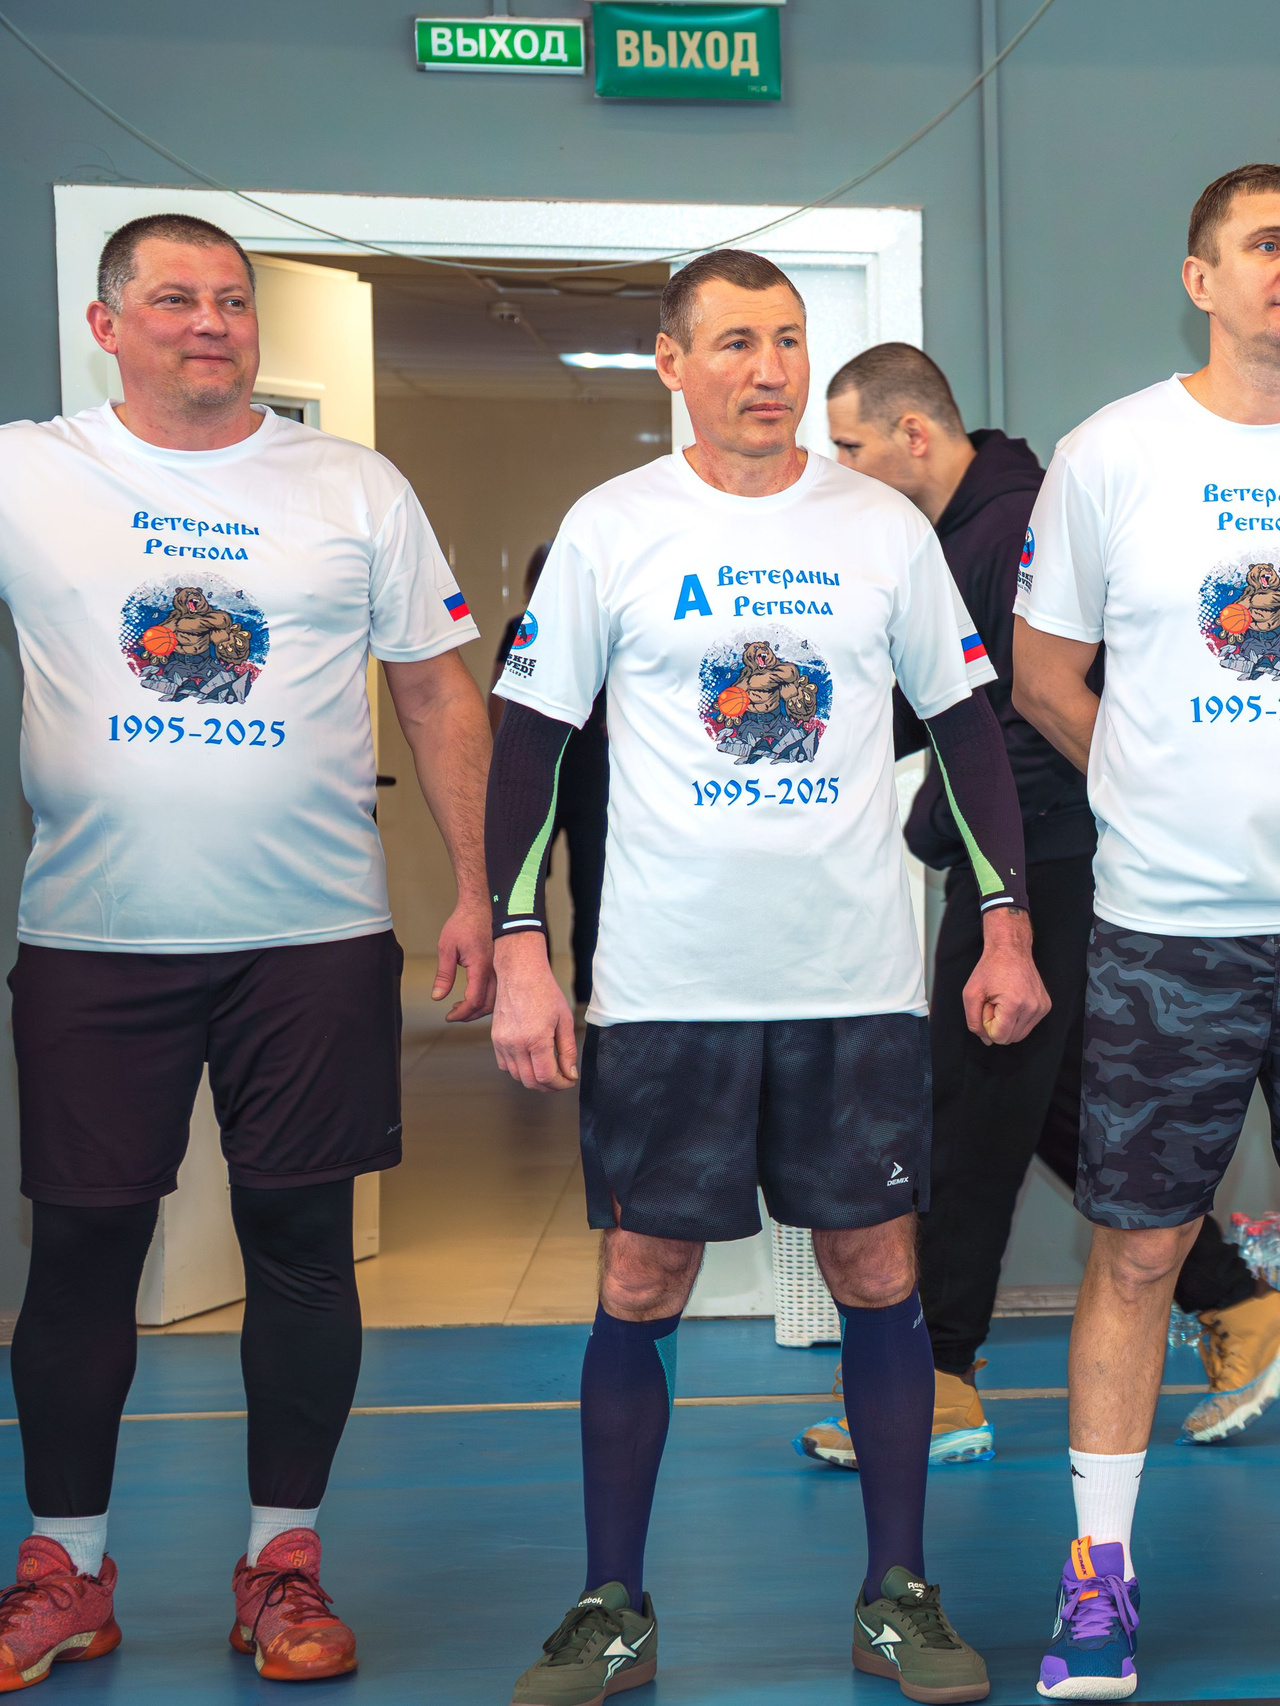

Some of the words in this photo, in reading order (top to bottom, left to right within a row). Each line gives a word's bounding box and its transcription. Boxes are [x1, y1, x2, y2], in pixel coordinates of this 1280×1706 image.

[430, 27, 568, 62] ВЫХОД
[616, 30, 760, 76] ВЫХОД
[131, 510, 261, 537] Ветераны
[717, 565, 841, 588] Ветераны
[673, 573, 713, 621] А
[108, 714, 287, 748] 1995-2025
[691, 777, 840, 807] 1995-2025
